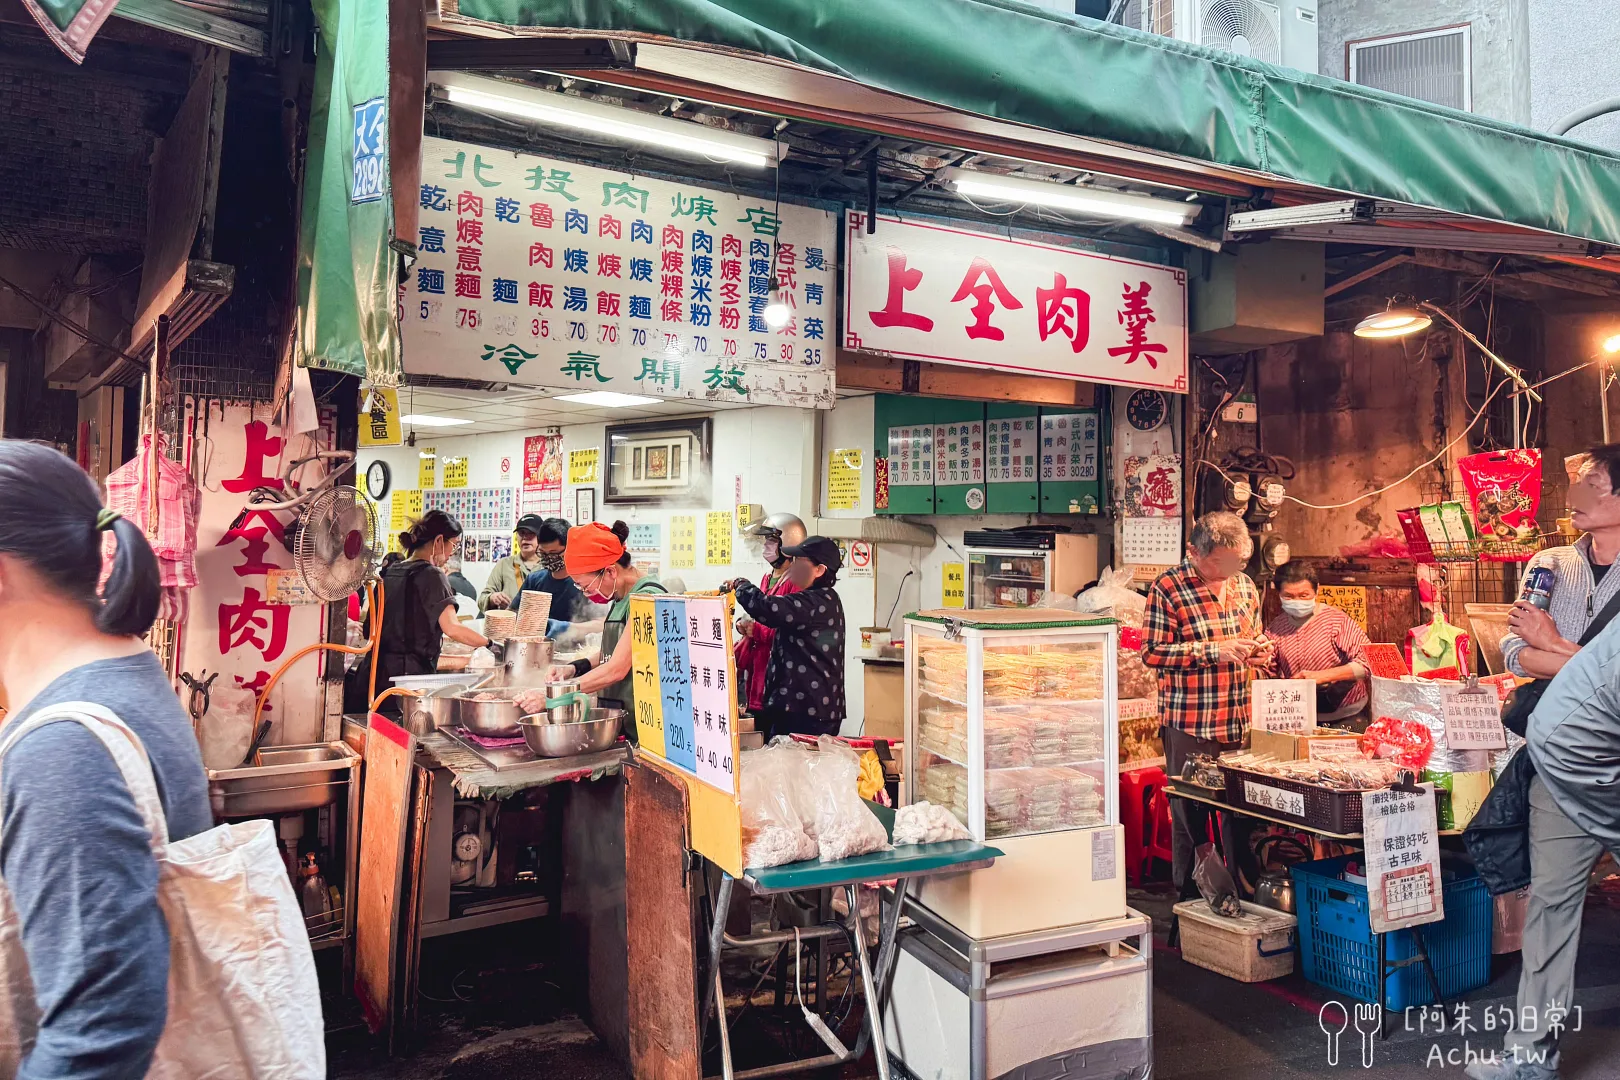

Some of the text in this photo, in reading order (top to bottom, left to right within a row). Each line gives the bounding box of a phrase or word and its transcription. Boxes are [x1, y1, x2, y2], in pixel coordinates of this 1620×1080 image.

[418, 184, 448, 294] 乾意麵
[492, 196, 520, 304] 乾麵
[528, 202, 554, 338] 魯肉飯 35
[868, 244, 1168, 370] 上全肉羹
[460, 308, 477, 328] 75
[570, 322, 585, 340] 70
[601, 325, 617, 342] 70
[632, 328, 647, 346] 70
[694, 336, 708, 352] 70
[723, 340, 737, 356] 70
[754, 342, 767, 358] 75
[780, 344, 793, 360] 30
[804, 348, 821, 366] 35
[480, 344, 749, 396] 冷氣開放
[1070, 418, 1080, 477] 各式小菜 30
[892, 473, 898, 483] 70
[901, 471, 908, 481] 70
[913, 472, 919, 481] 75
[923, 471, 930, 480] 70
[938, 471, 946, 480] 70
[950, 471, 957, 480] 70
[961, 471, 969, 481] 70
[973, 470, 980, 479] 70
[990, 468, 997, 478] 70
[1002, 468, 1009, 478] 75
[1043, 466, 1052, 478] 35
[1056, 466, 1066, 477] 35
[662, 608, 680, 635] 貢丸
[664, 647, 683, 674] 花枝
[636, 664, 653, 687] 一斤
[667, 690, 684, 712] 一斤
[1266, 690, 1301, 704] 苦茶油
[717, 669, 732, 774] 原味 40
[696, 744, 704, 762] 40
[708, 751, 717, 768] 40
[1247, 786, 1303, 814] 檢驗合格
[1381, 801, 1415, 816] 檢驗合格
[1384, 832, 1429, 852] 保證好吃
[1389, 850, 1422, 868] 古早味
